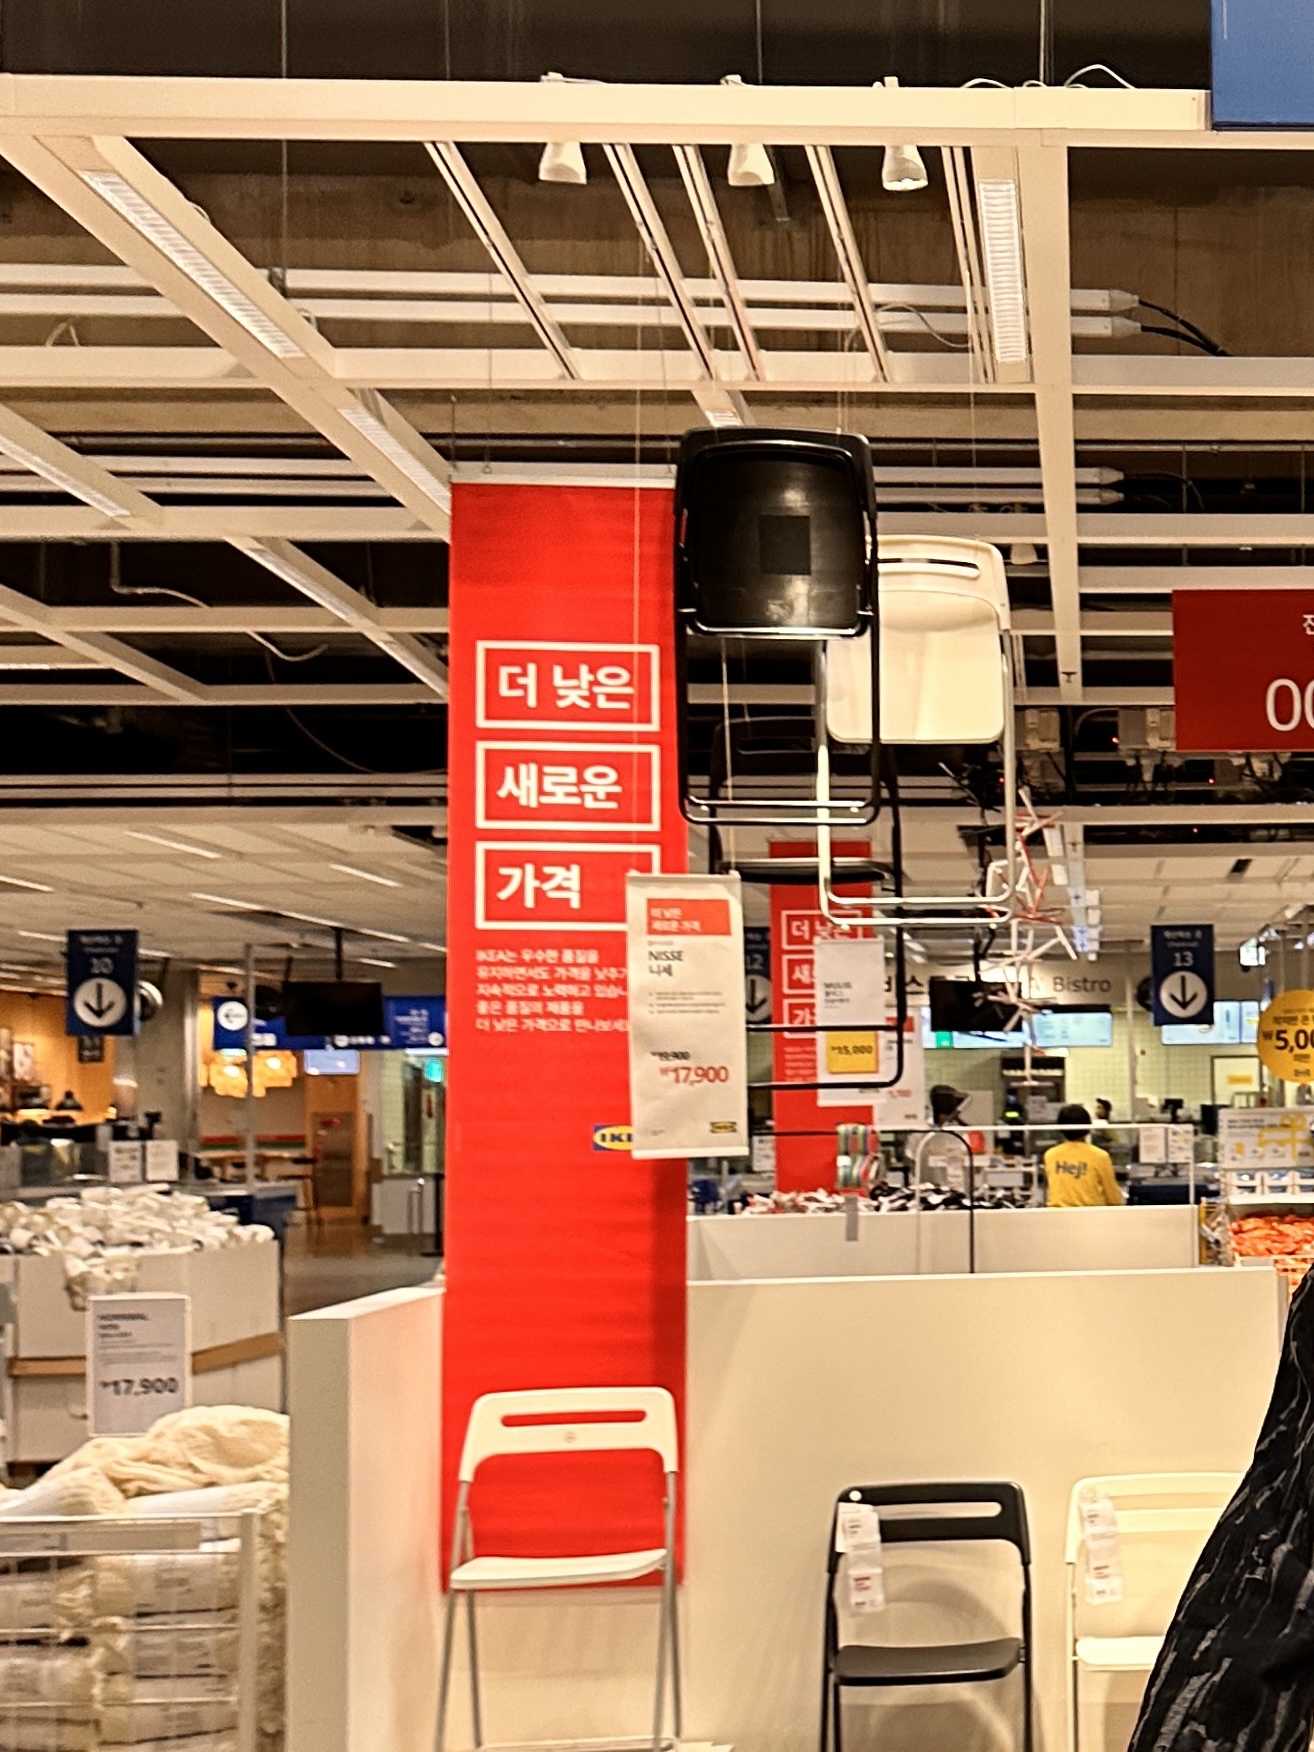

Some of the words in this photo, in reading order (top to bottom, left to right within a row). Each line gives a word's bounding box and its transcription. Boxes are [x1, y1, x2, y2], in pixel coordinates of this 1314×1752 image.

[498, 662, 538, 708] 더
[552, 663, 635, 709] 낮은
[496, 762, 622, 810] 새로운
[496, 862, 581, 910] 가격
[791, 919, 810, 940] 더
[648, 950, 684, 962] NISSE
[1173, 951, 1194, 967] 13
[1053, 976, 1112, 993] Bistro
[475, 1018, 490, 1032] 더
[492, 1018, 519, 1033] 낮은
[1055, 1160, 1088, 1180] Hej!
